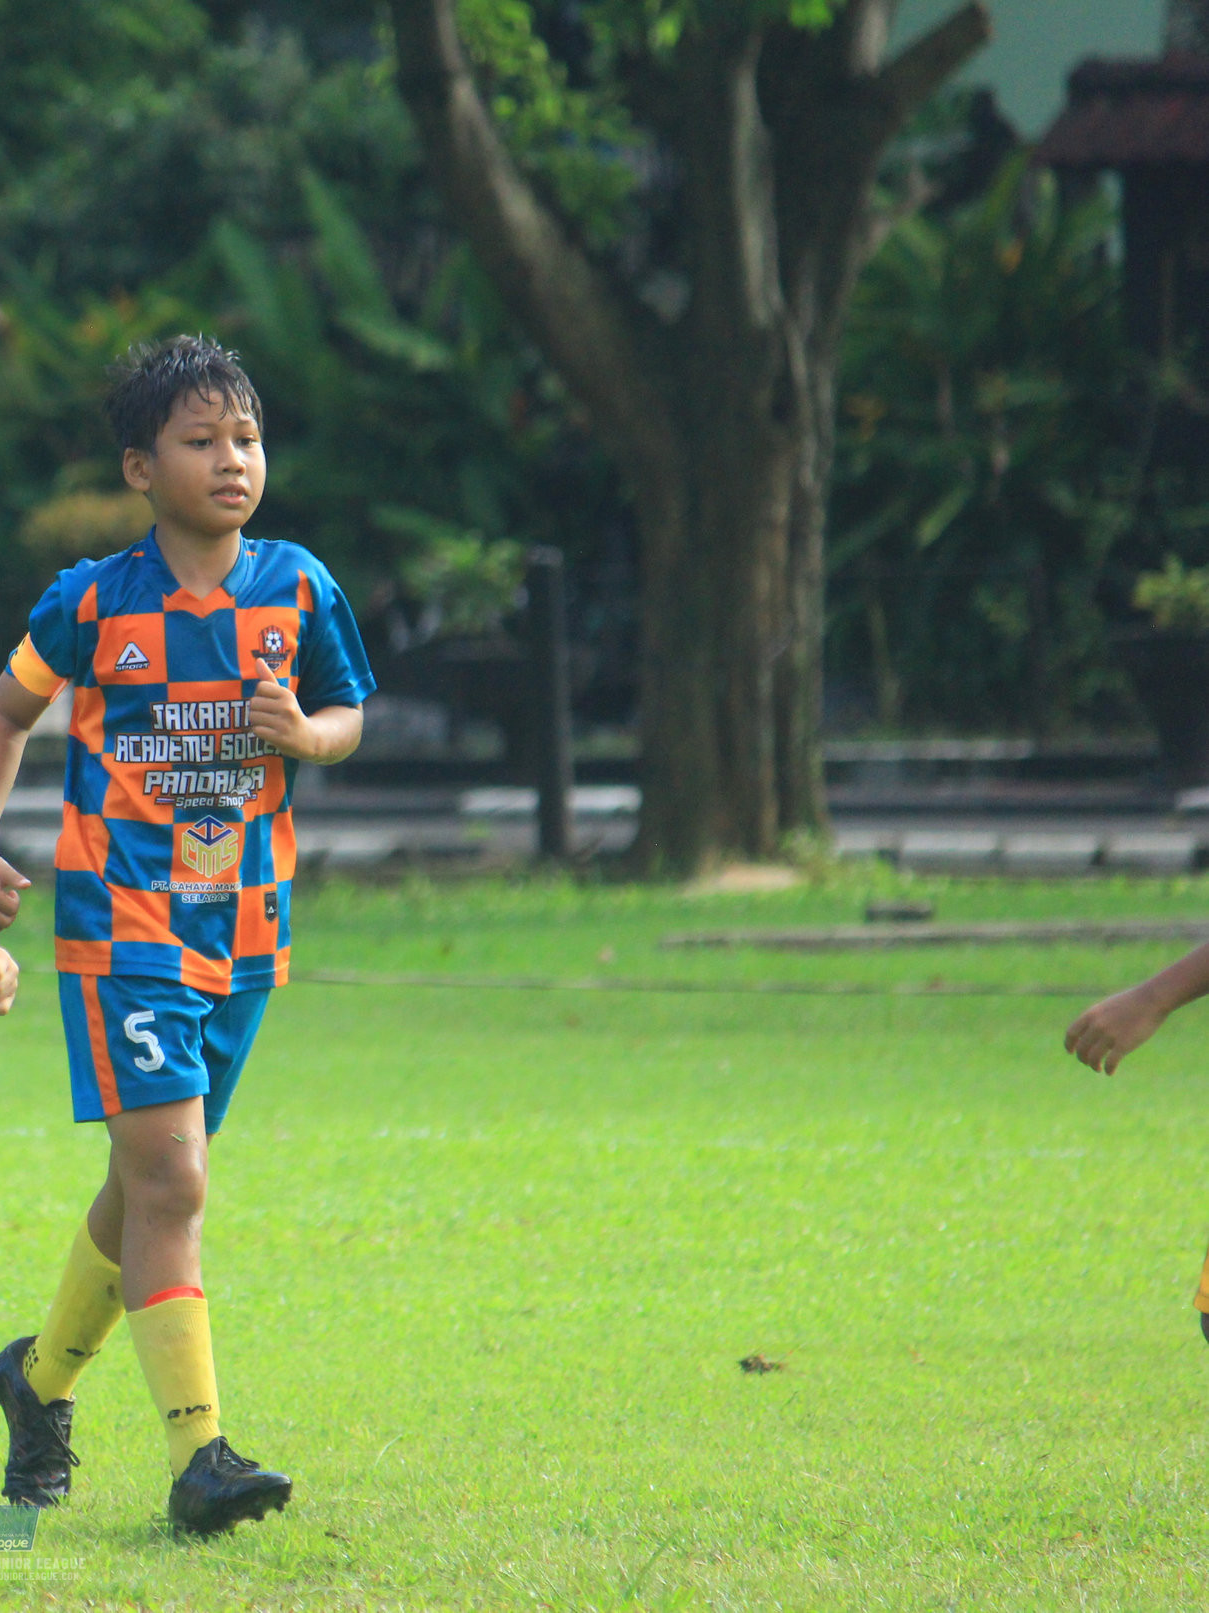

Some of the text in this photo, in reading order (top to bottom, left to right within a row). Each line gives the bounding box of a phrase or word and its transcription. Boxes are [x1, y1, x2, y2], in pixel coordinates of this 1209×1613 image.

[116, 735, 214, 762] ACADEMY
[176, 796, 244, 809] Speed Shop
[182, 832, 238, 878] CMS
[170, 882, 212, 891] CAHAYA
[214, 883, 242, 891] MAK
[182, 893, 230, 903] SELARAS
[124, 1010, 165, 1072] 5
